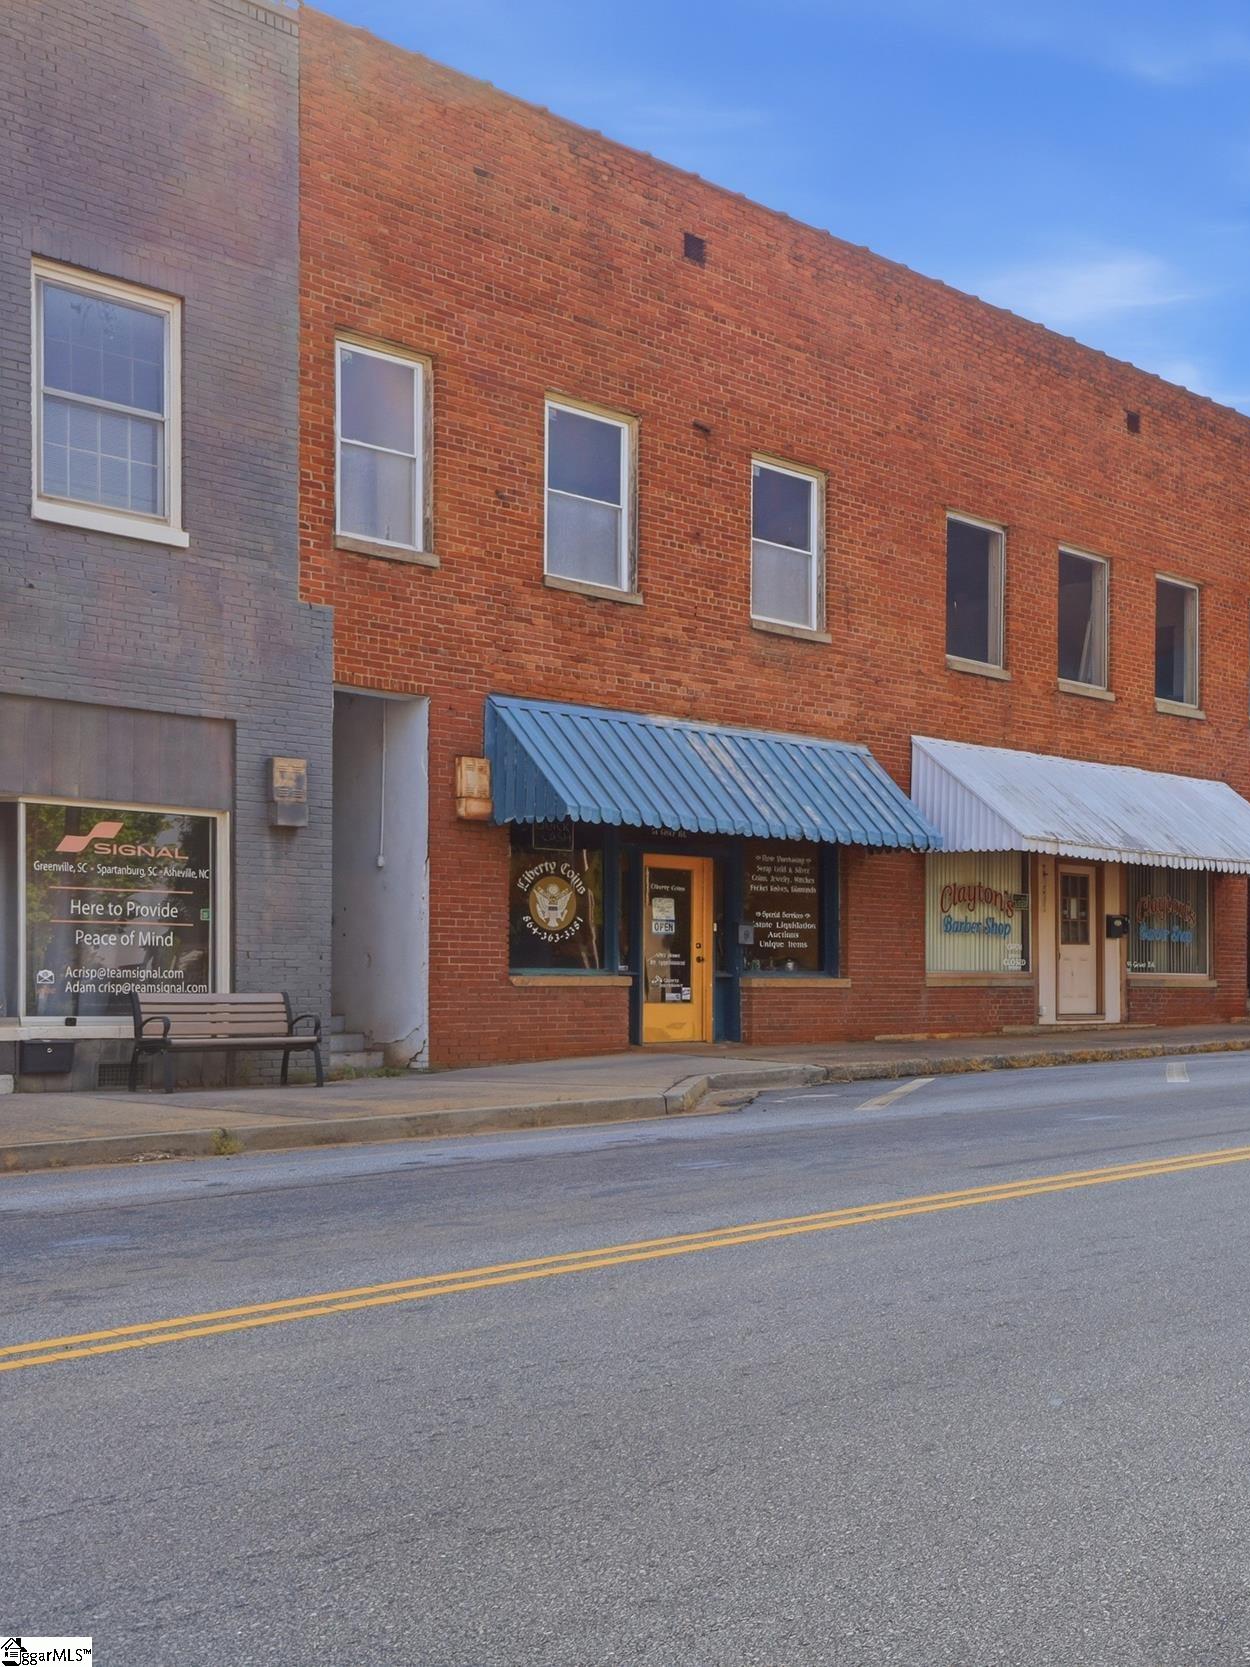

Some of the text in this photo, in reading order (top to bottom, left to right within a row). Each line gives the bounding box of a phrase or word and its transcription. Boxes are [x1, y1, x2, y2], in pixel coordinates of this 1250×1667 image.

[94, 842, 189, 860] SIGNAL
[33, 860, 76, 874] Greenville,
[77, 862, 88, 873] SC
[147, 866, 158, 877] SC
[198, 868, 210, 880] NC
[516, 861, 586, 895] Liberty Coins
[70, 899, 179, 918] Here to Provide
[940, 882, 1014, 919] Clayton's
[654, 922, 674, 932] OPEN
[776, 921, 817, 930] Liquidation
[943, 915, 1012, 940] Barber Shop
[76, 929, 174, 947] Peace of Mind
[767, 931, 800, 939] Auctions
[759, 940, 808, 949] Unique Items
[1003, 958, 1027, 967] CLOSED
[65, 966, 184, 982] Acrisp@teamsignal.com
[65, 980, 208, 995] Adam crisp@teamsignal.com
